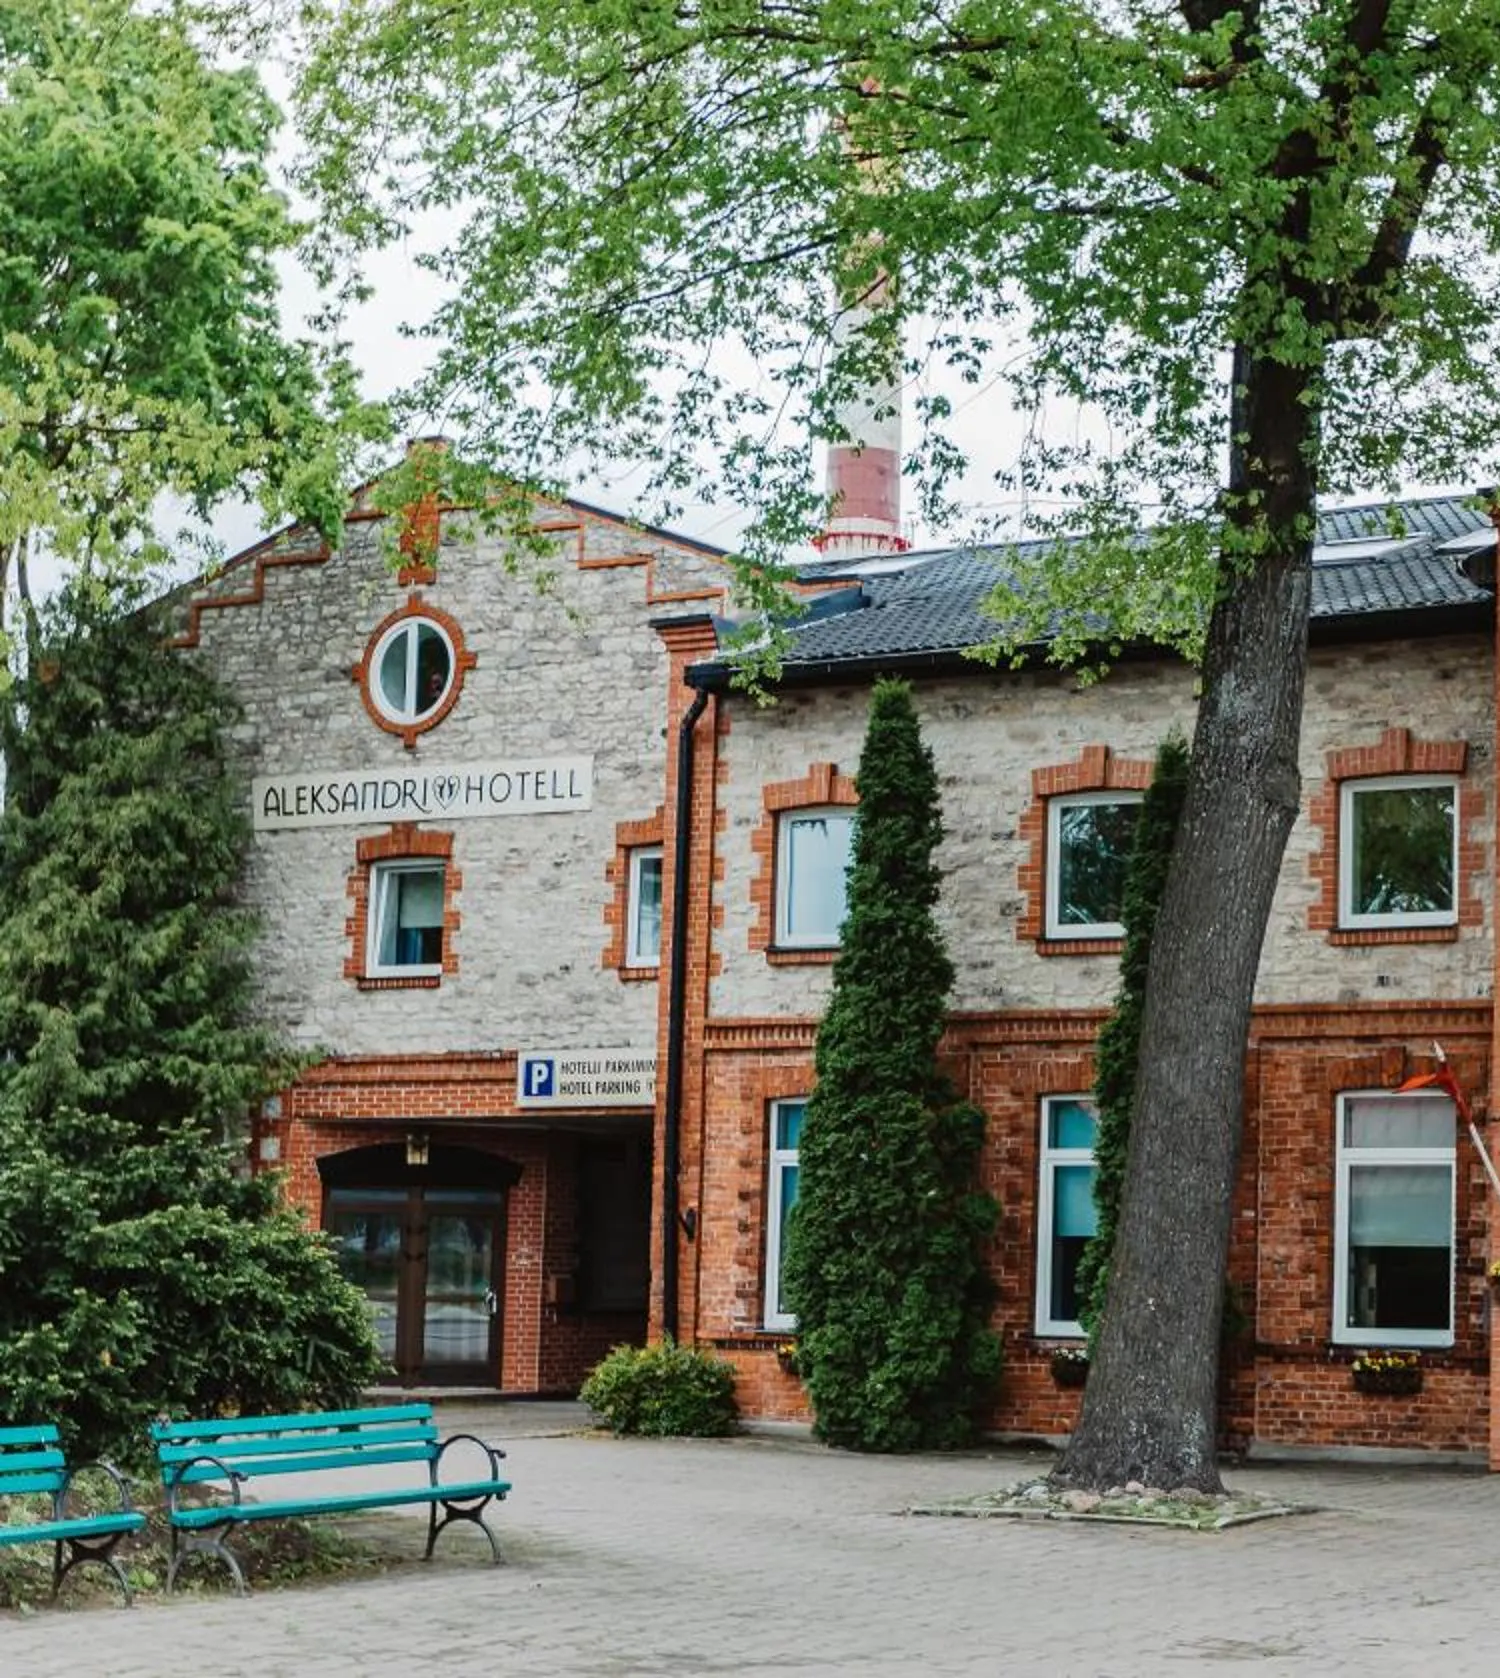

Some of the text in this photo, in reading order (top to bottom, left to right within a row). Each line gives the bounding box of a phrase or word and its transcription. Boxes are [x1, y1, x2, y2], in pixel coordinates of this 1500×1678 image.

[263, 768, 583, 817] ALEKSANDRI HOTELL
[531, 1062, 549, 1095] P
[560, 1079, 641, 1095] HOTEL PARKING
